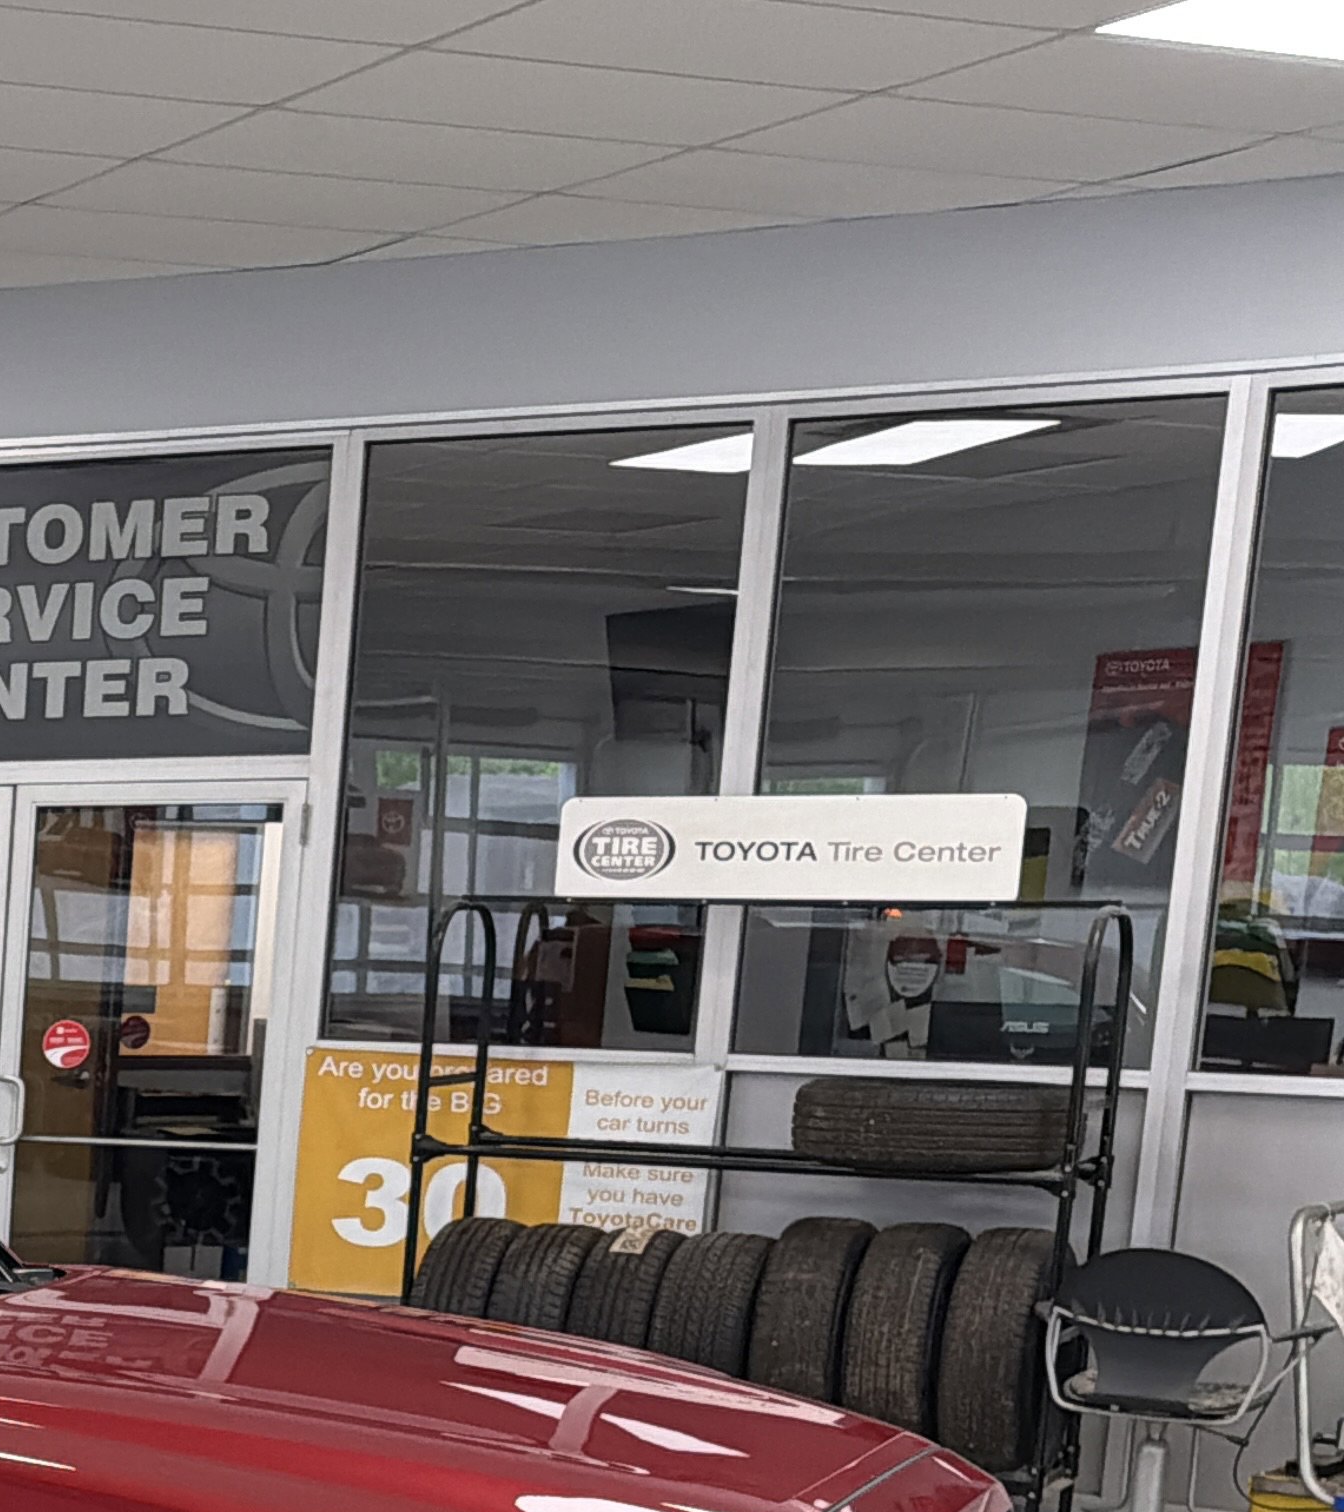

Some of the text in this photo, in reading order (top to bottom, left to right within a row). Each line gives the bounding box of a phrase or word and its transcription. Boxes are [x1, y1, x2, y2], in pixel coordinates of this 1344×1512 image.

[1123, 658, 1170, 673] TOYOTA
[616, 827, 649, 835] TOYOTA
[592, 837, 658, 855] TIRE
[695, 841, 1002, 863] TOYOTA Tire Center
[591, 856, 656, 867] CENTER
[1000, 1021, 1050, 1033] ASUS
[318, 1056, 548, 1086] Are you prared
[359, 1087, 394, 1109] for
[450, 1092, 502, 1115] BG
[585, 1089, 708, 1113] Before your
[597, 1116, 690, 1135] car turns
[583, 1163, 694, 1183] Make sure
[330, 1157, 507, 1247] 30
[587, 1188, 684, 1206] you have
[569, 1208, 697, 1231] ToyotaCare
